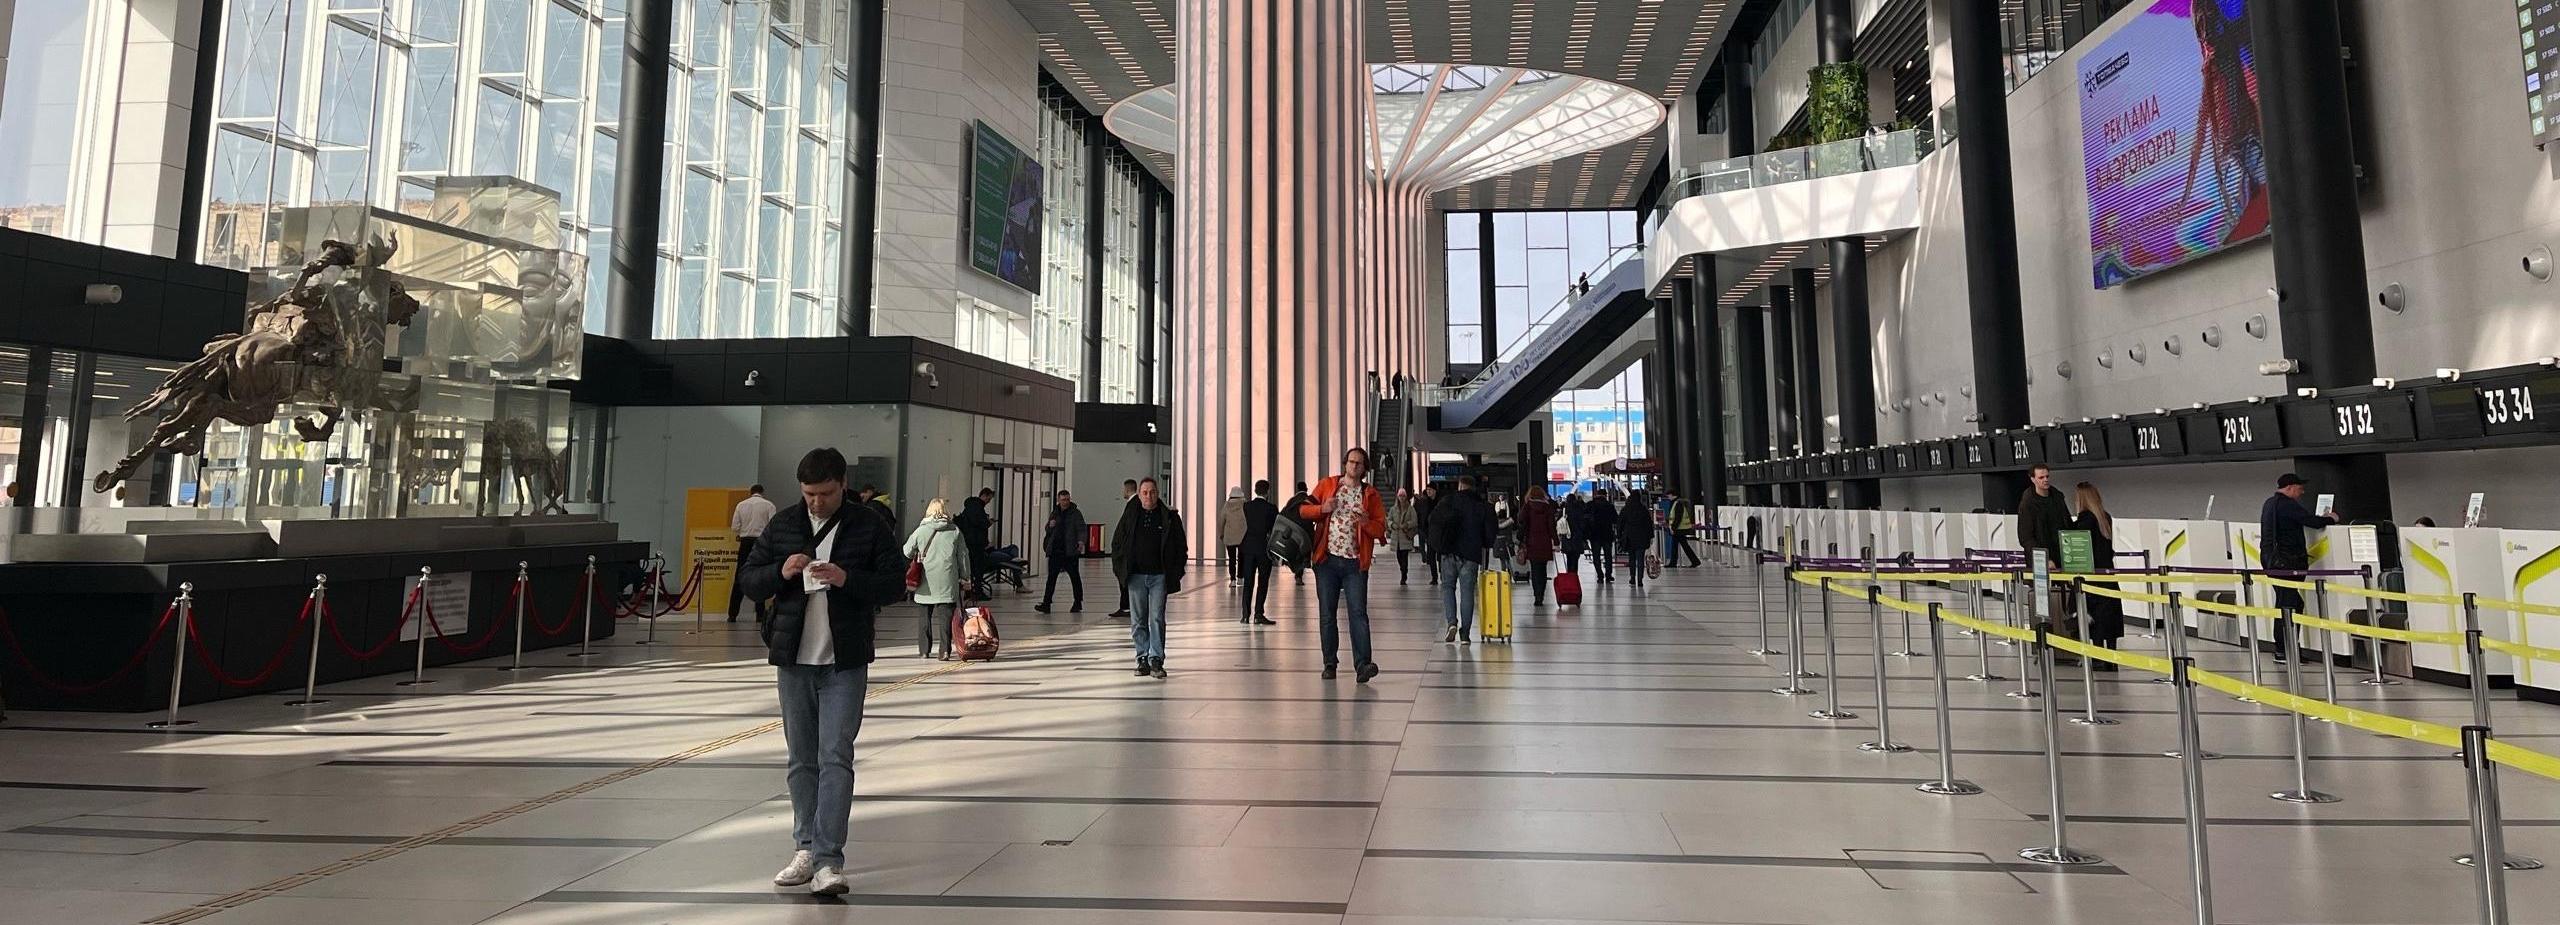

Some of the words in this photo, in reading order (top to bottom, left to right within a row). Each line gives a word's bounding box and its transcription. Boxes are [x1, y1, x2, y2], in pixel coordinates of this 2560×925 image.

[2103, 94, 2160, 146] РЕКЛАМА
[2105, 126, 2177, 187] АЭРОПОРТУ
[2337, 406, 2353, 435] 31
[2355, 403, 2374, 434] 32
[2484, 389, 2508, 424] 33
[2510, 386, 2534, 421] 34
[2069, 434, 2079, 455] 25
[2137, 427, 2148, 450] 27
[2224, 418, 2237, 444] 29
[2014, 440, 2022, 459] 23
